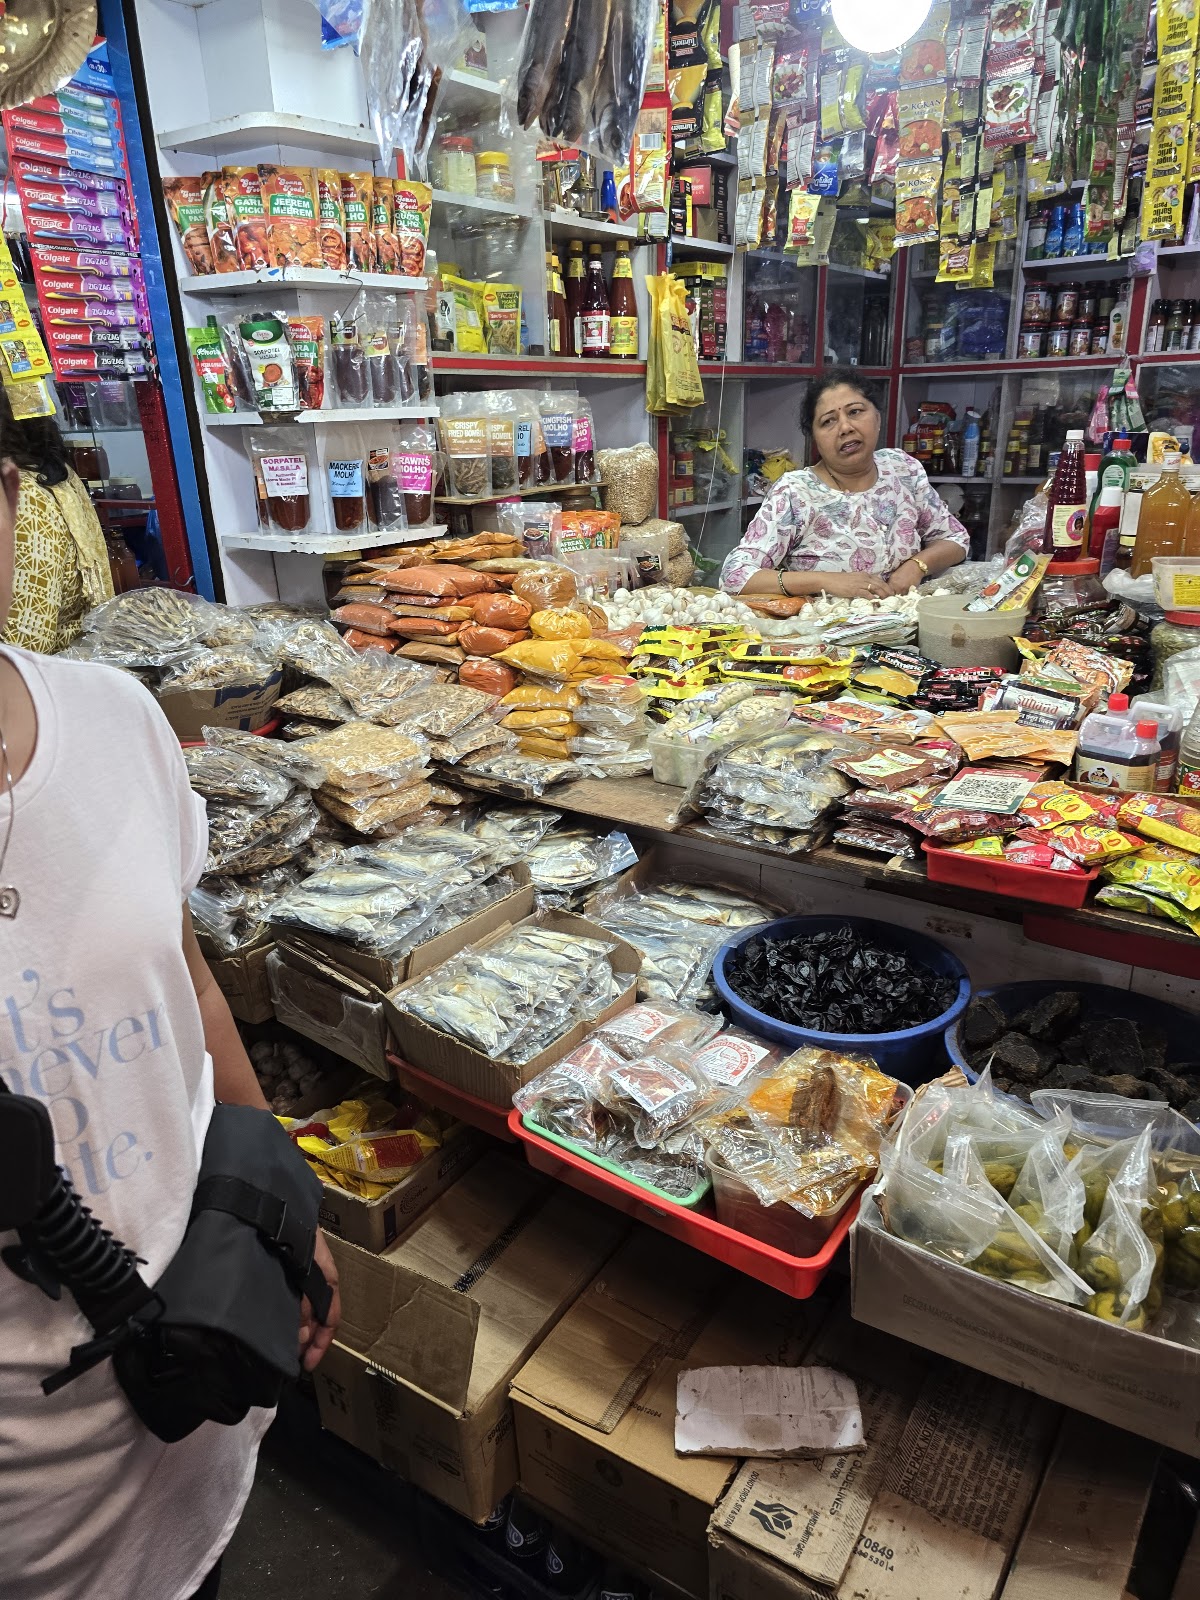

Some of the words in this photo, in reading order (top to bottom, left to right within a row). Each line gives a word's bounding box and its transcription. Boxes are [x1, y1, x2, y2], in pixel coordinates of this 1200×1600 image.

[1168, 22, 1188, 32] Garlic
[1166, 31, 1189, 41] Ginger
[1162, 85, 1182, 95] Garlic
[1161, 94, 1183, 104] Ginger
[911, 99, 941, 110] KOKAN
[63, 106, 84, 118] Cibaca
[12, 114, 38, 127] Colgate
[67, 127, 88, 138] Cibaca
[15, 136, 41, 149] Colgate
[70, 149, 91, 159] Cibaca
[1158, 147, 1177, 156] Garlic
[1156, 155, 1178, 165] Ginger
[19, 161, 53, 174] Colgate
[908, 177, 936, 188] KOKAN
[24, 190, 57, 202] Colgate
[274, 198, 310, 209] JEEREM
[272, 206, 313, 218] MEEREM
[1153, 207, 1173, 216] Garlic
[1151, 214, 1173, 224] Ginger
[30, 218, 63, 230] Colgate
[76, 223, 88, 231] ZIG
[88, 224, 101, 233] ZAG
[38, 253, 70, 264] Colgate
[85, 257, 95, 265] ZIG
[96, 258, 108, 266] ZAG
[43, 279, 74, 290] Colgate
[48, 306, 78, 316] Colgate
[92, 308, 102, 316] ZIG
[53, 332, 83, 342] Colgate
[96, 333, 107, 341] ZIG
[108, 333, 120, 341] ZAG
[58, 358, 88, 367] Colgate
[112, 358, 124, 366] ZAG
[542, 414, 572, 424] KINGFISH
[454, 421, 479, 429] CRISPY
[543, 424, 568, 432] MOLHO
[448, 430, 465, 438] FRIED
[465, 429, 486, 438] BOMBIL
[492, 432, 513, 440] BOMBIL
[263, 457, 305, 466] SORPATEL
[268, 464, 301, 472] MASALA
[0, 969, 85, 1054] t's
[909, 1445, 925, 1470] PACK
[829, 1459, 863, 1516] GUIDELINES
[806, 1510, 821, 1530] HANDLE
[857, 1534, 894, 1560] 70849
